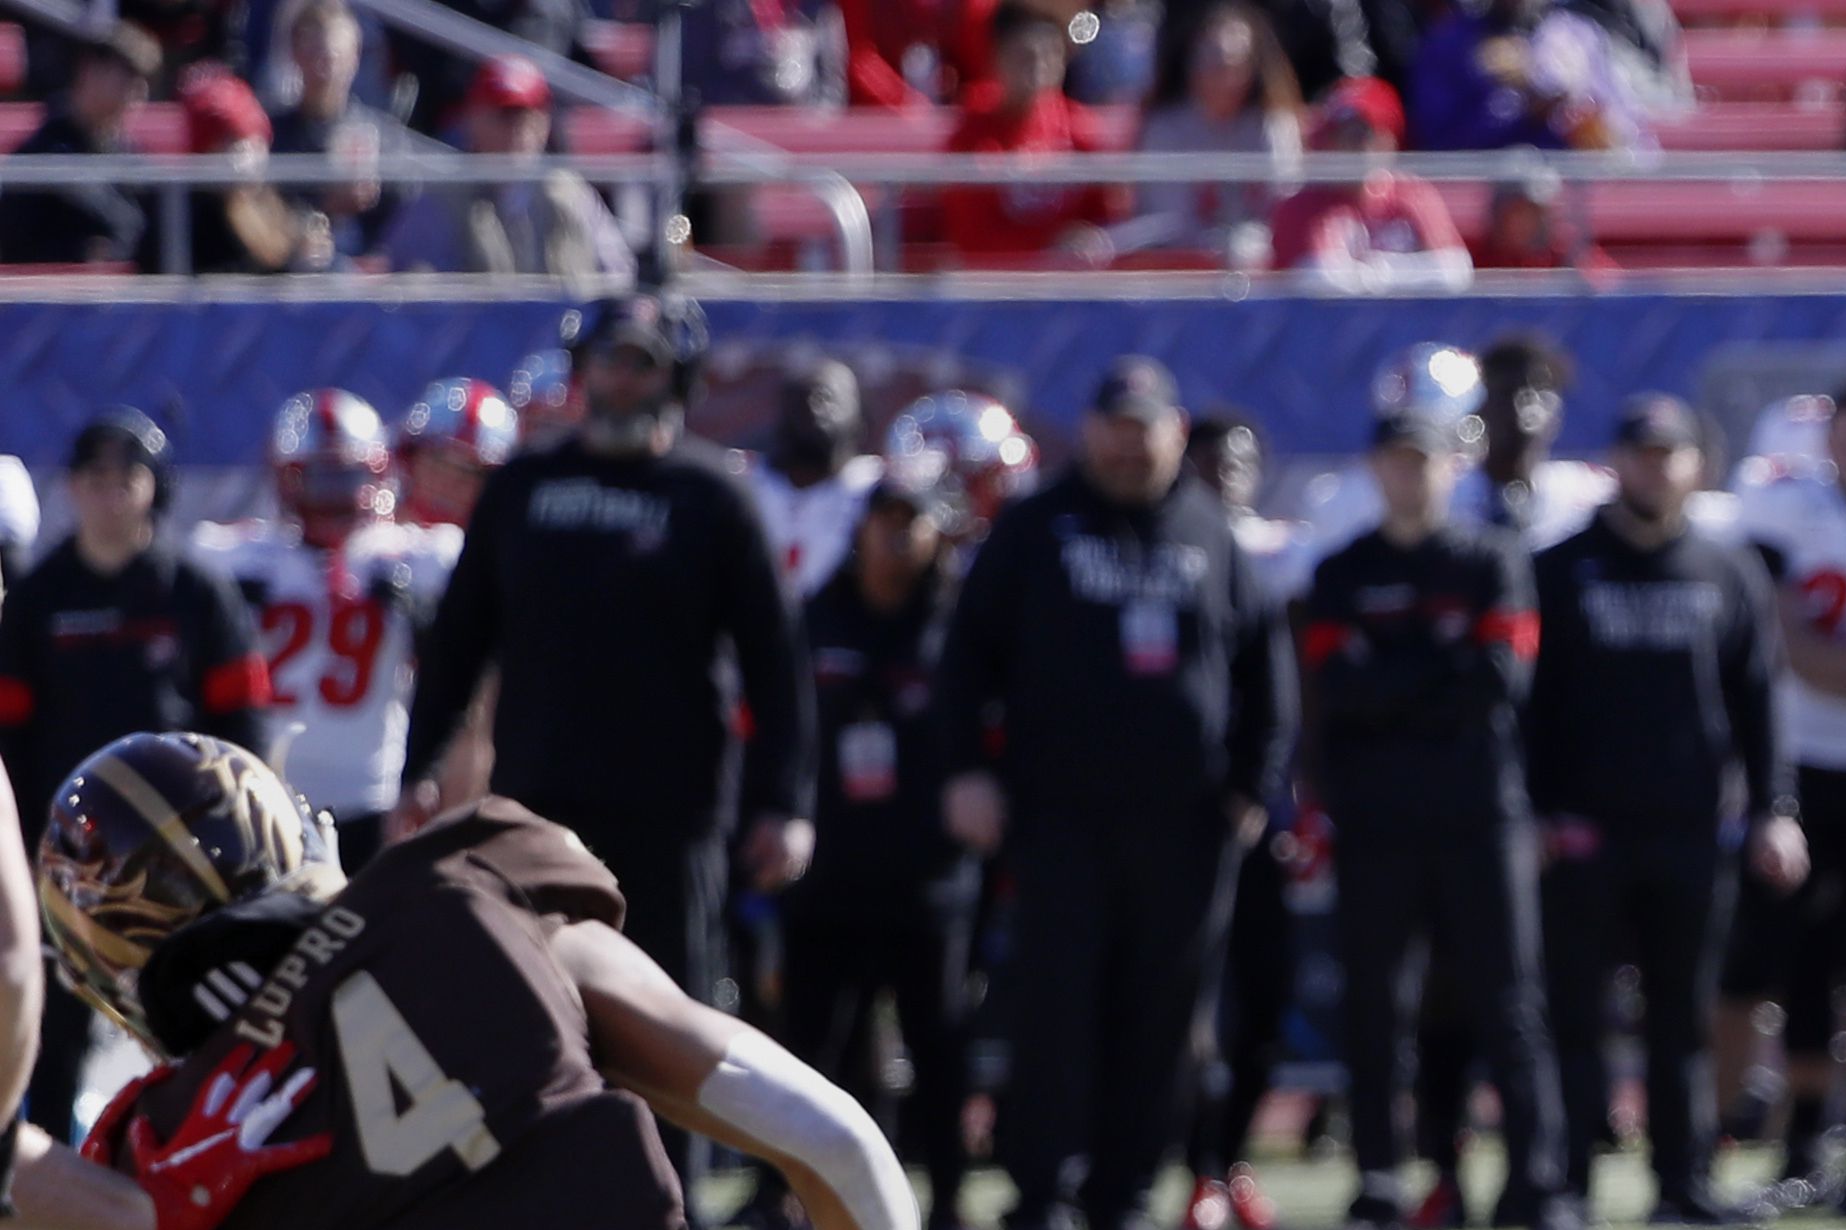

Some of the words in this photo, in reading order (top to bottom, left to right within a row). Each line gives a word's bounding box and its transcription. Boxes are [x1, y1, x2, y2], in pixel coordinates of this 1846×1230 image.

[261, 604, 384, 707] 29
[235, 906, 366, 1048] LUPRO
[332, 969, 501, 1176] 4
